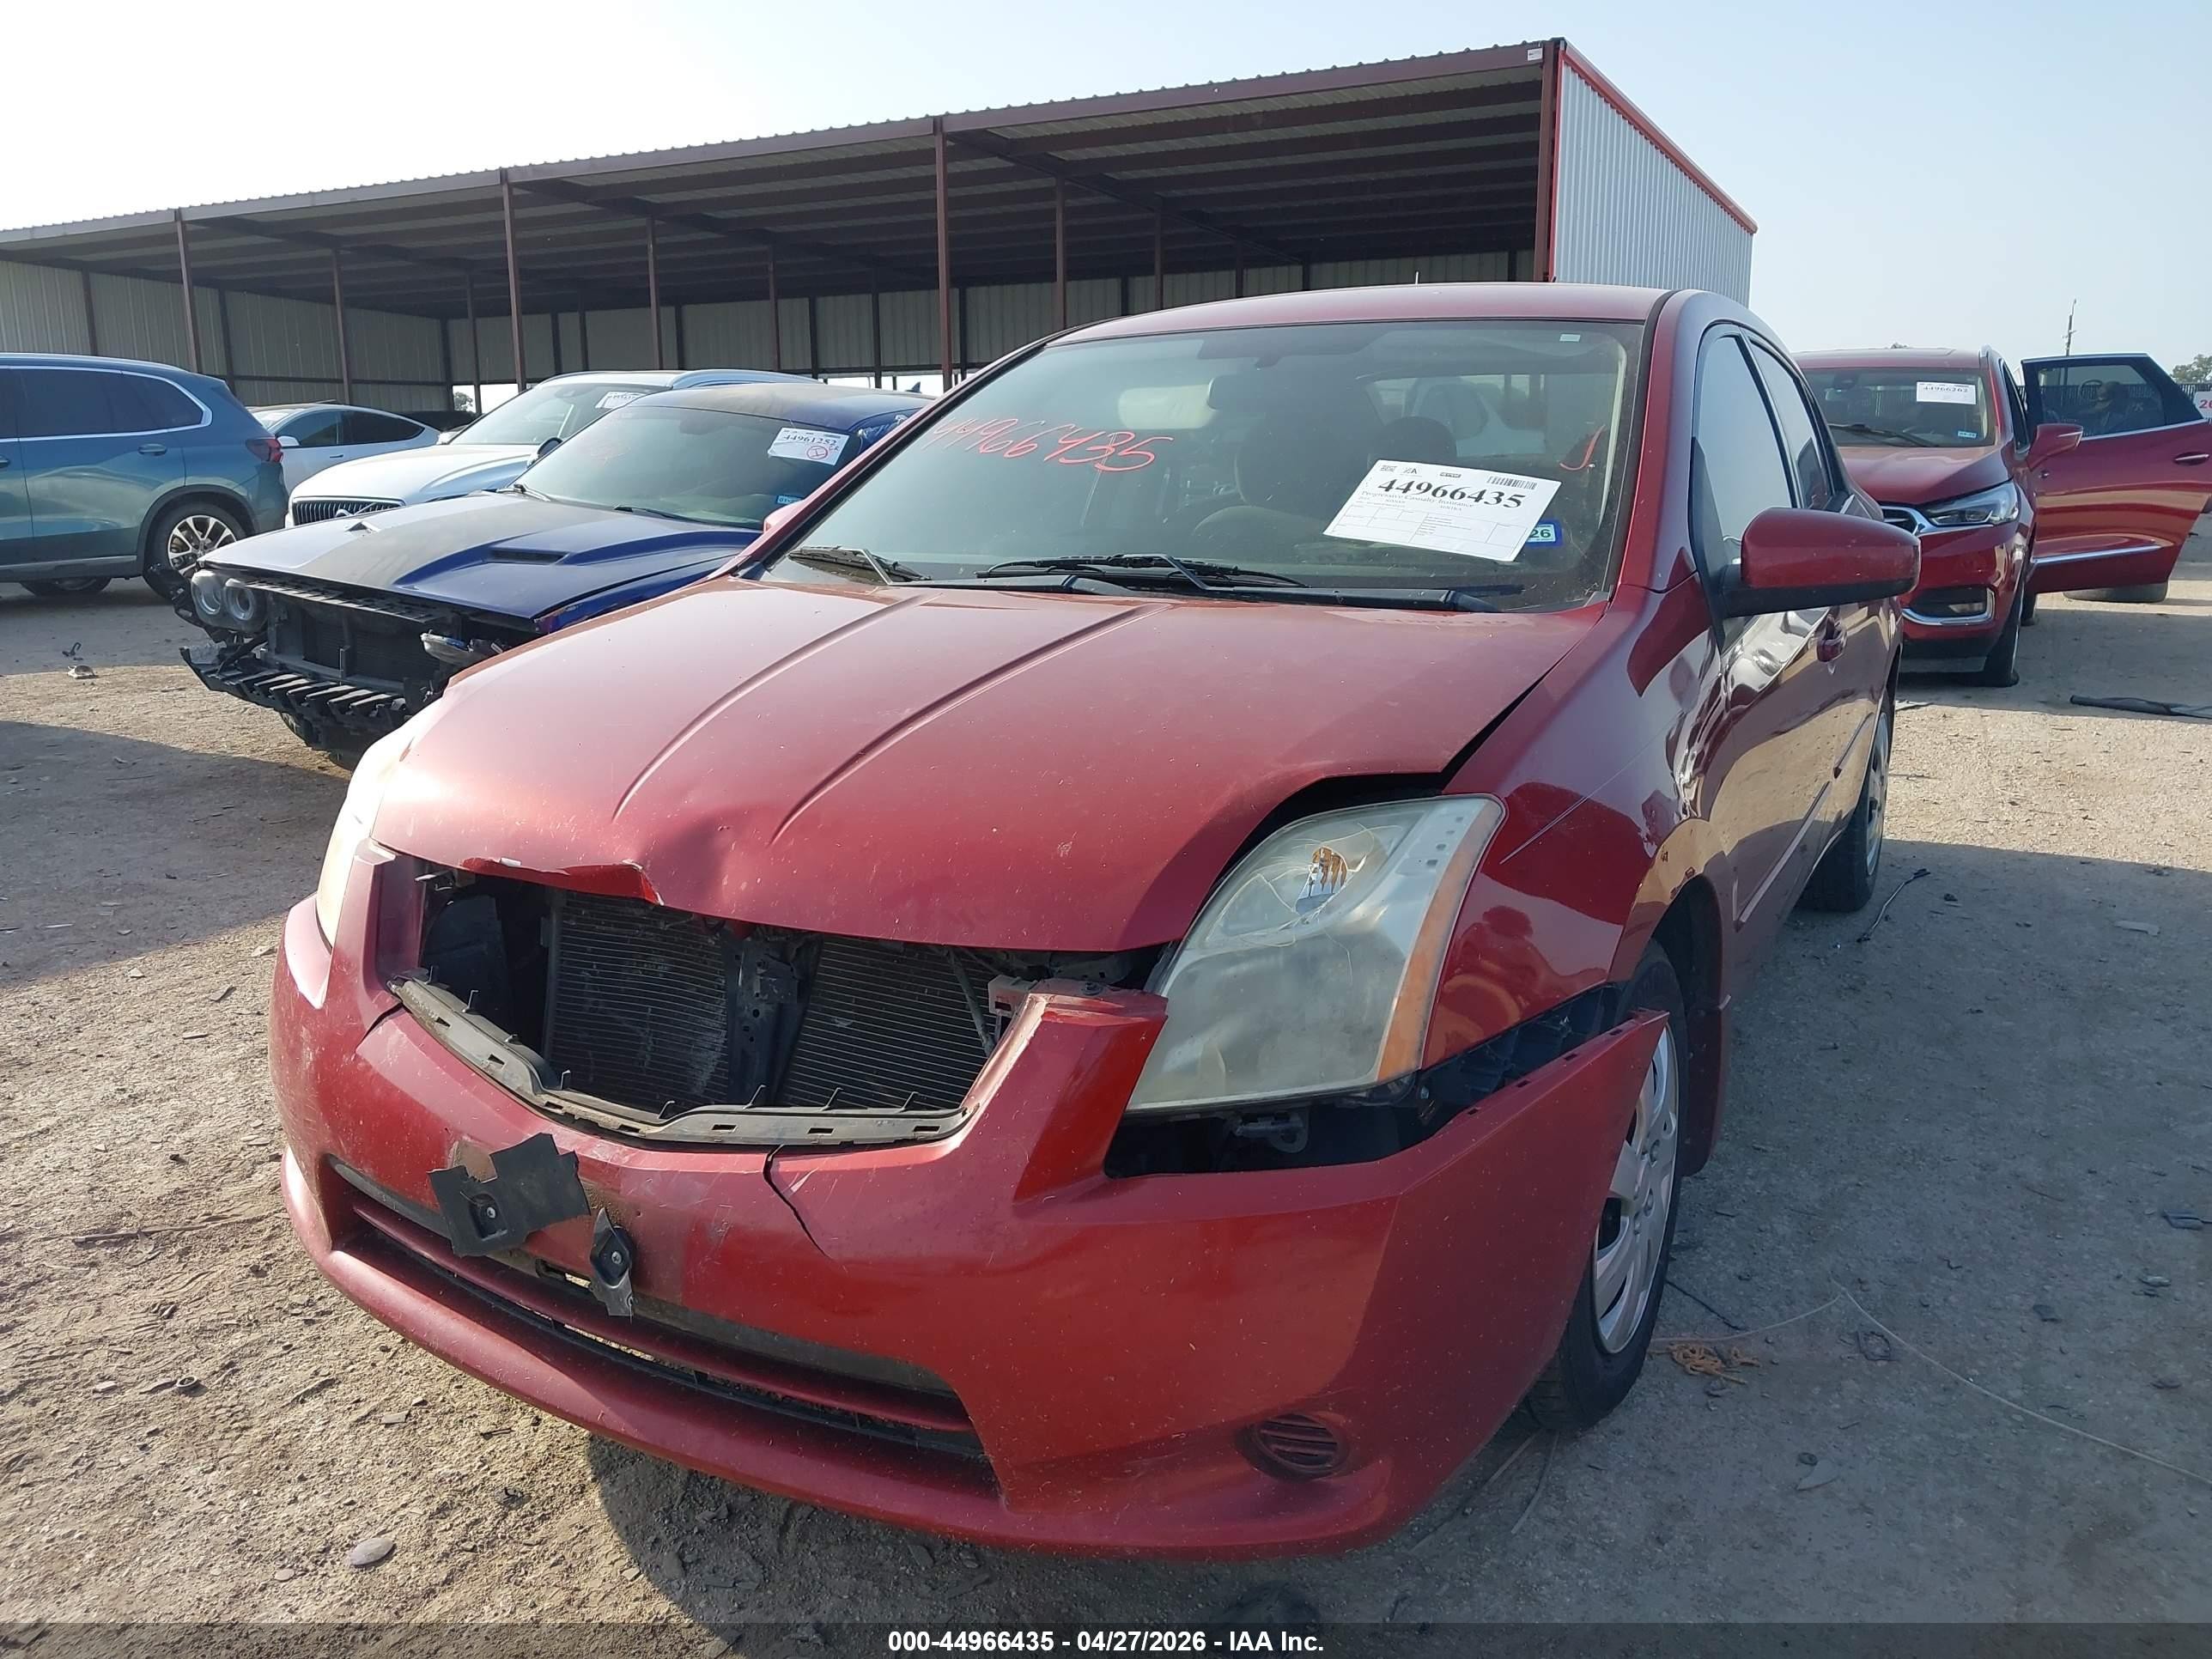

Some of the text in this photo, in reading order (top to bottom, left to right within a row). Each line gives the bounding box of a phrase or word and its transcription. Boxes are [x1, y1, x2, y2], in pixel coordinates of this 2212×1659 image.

[1377, 478, 1528, 509] 44966435
[1438, 499, 1475, 508] Insurance
[1528, 528, 1552, 538] 26
